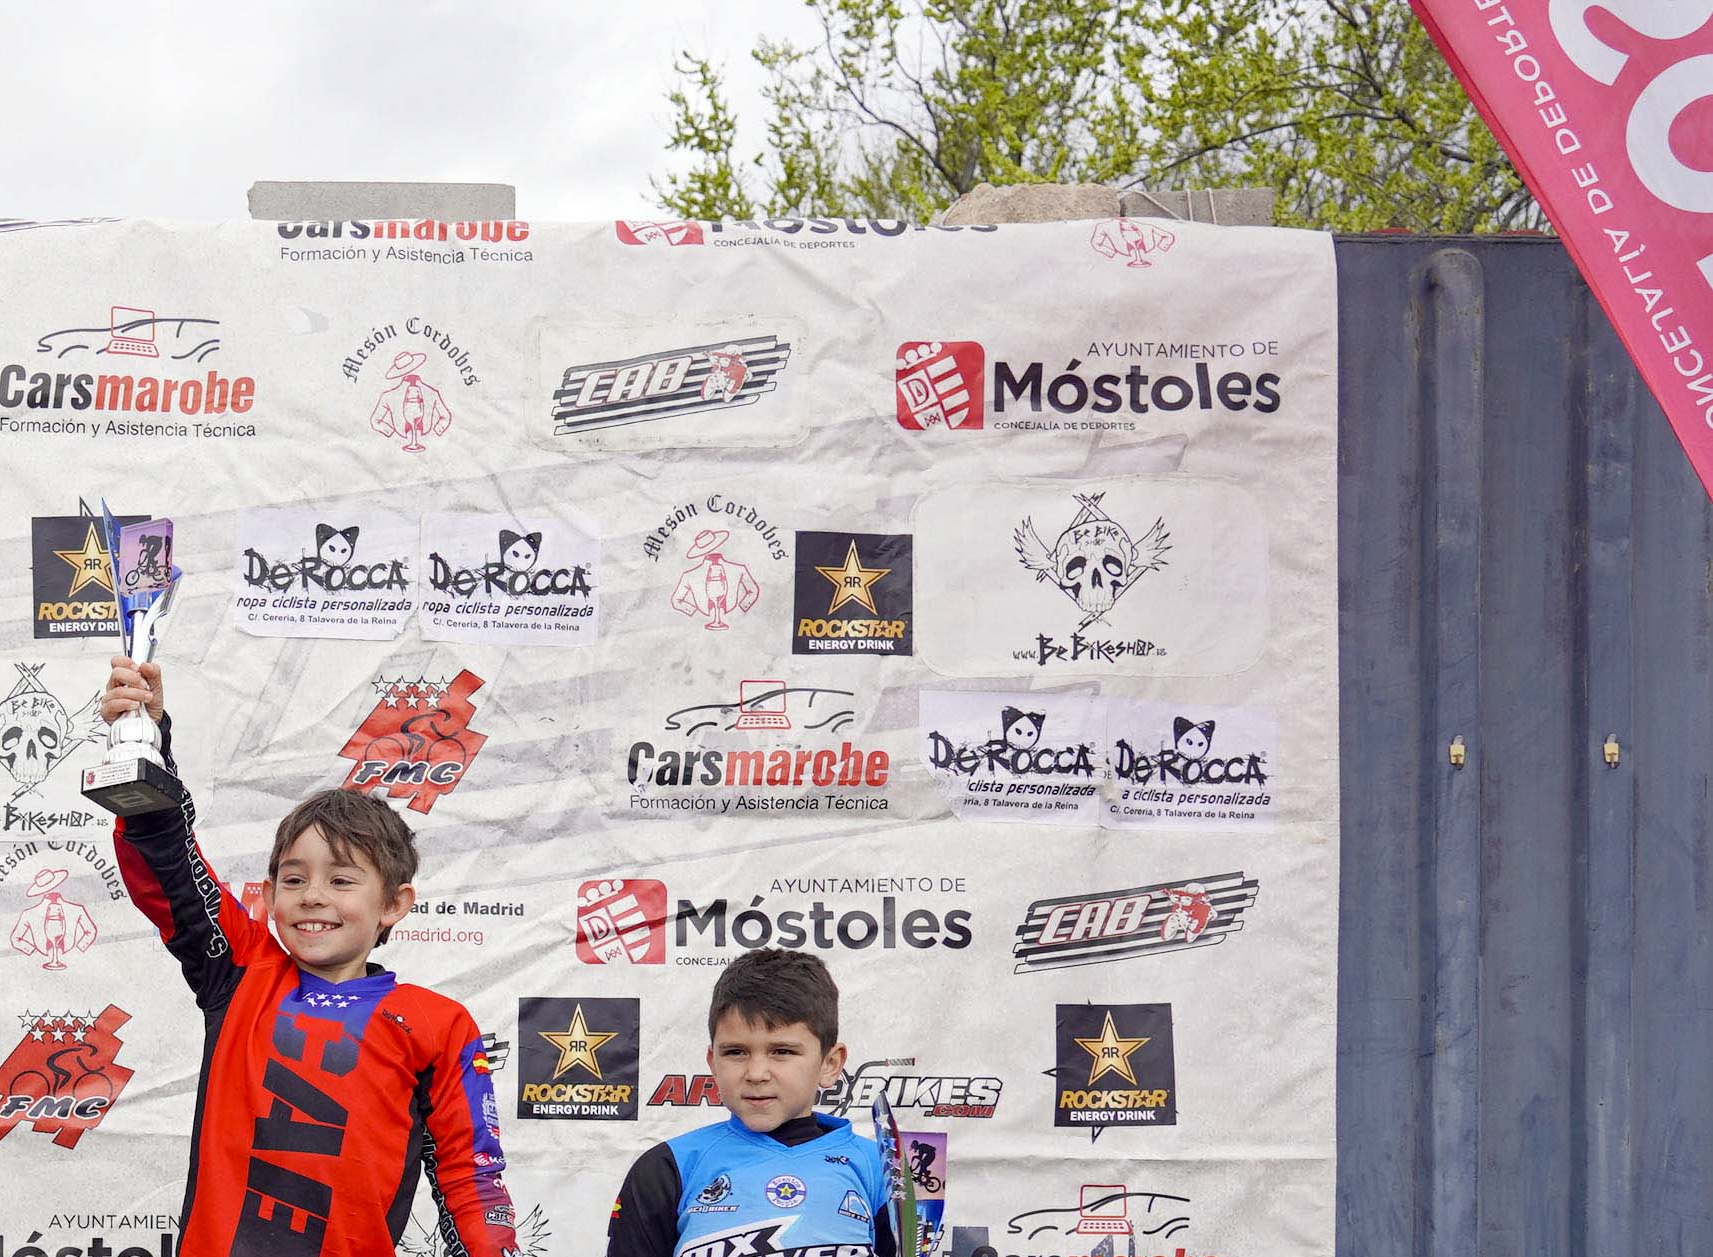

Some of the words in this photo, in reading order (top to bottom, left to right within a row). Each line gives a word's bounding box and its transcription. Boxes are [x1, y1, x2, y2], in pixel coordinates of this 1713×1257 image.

[713, 237, 781, 248] CONCEJALÍA
[783, 239, 798, 249] DE
[799, 240, 856, 249] DEPORTES
[280, 246, 367, 261] Formación
[372, 249, 382, 263] y
[385, 245, 464, 265] Asistencia
[469, 246, 534, 262] Técnica
[1086, 340, 1246, 361] AYUNTAMIENTO
[1252, 340, 1280, 357] DE
[575, 355, 693, 409] CAB
[993, 358, 1283, 415] Móstoles
[0, 416, 88, 434] Formación
[90, 421, 101, 439] y
[104, 418, 188, 437] Asistencia
[192, 420, 257, 438] Técnica
[994, 419, 1061, 431] CONCEJALÍA
[1063, 421, 1078, 430] DE
[1080, 421, 1137, 432] DEPORTES
[38, 601, 119, 620] ROCKST
[236, 597, 267, 611] ropa
[271, 597, 317, 610] ciclista
[321, 598, 412, 613] personalizada
[422, 601, 451, 615] ropa
[455, 602, 501, 615] ciclista
[504, 603, 595, 618] personalizada
[49, 622, 98, 633] ENERGY
[98, 621, 119, 633] DRI
[299, 614, 305, 624] 8
[308, 615, 345, 624] Talavera
[347, 617, 359, 625] de
[361, 616, 369, 625] la
[371, 617, 397, 626] Reina
[482, 620, 489, 629] 8
[491, 621, 529, 629] Talavera
[531, 622, 542, 630] de
[544, 622, 552, 631] la
[554, 622, 580, 632] Reina
[797, 619, 905, 639] ROCKSTAR
[808, 639, 855, 650] ENERGY
[856, 639, 895, 650] DRINK
[627, 740, 890, 788] Carsmarobe
[351, 760, 465, 786] FMC
[966, 780, 1004, 793] iclista
[1006, 782, 1097, 797] personalizada
[630, 794, 717, 810] Formación
[720, 799, 732, 814] y
[736, 794, 819, 811] Asistencia
[824, 794, 890, 811] Técnica
[983, 798, 990, 807] 8
[992, 799, 1029, 809] Talavera
[1032, 801, 1043, 809] de
[1045, 801, 1053, 810] la
[1055, 802, 1079, 810] Reina
[1132, 789, 1174, 803] ciclista
[1177, 791, 1271, 806] personalizada
[1156, 808, 1162, 817] 8
[1164, 808, 1202, 818] Talavera
[1205, 810, 1215, 818] de
[1218, 810, 1226, 819] la
[1228, 811, 1255, 819] Reina
[769, 876, 936, 894] AYUNTAMIENTO
[940, 877, 968, 893] DE
[435, 901, 457, 915] de
[462, 902, 525, 917] Madrid
[675, 894, 974, 951] Móstoles
[1037, 894, 1153, 946] CAB
[389, 928, 485, 946] .madrid.org
[521, 1083, 632, 1105] ROCKSTAR
[1059, 1089, 1170, 1109] ROCKSTAR
[532, 1104, 579, 1116] ENERGY
[581, 1104, 619, 1116] DRINK
[1070, 1110, 1116, 1123] ENERGY
[1118, 1109, 1156, 1122] DRINK
[48, 1214, 181, 1231] AYUNTAMIEN
